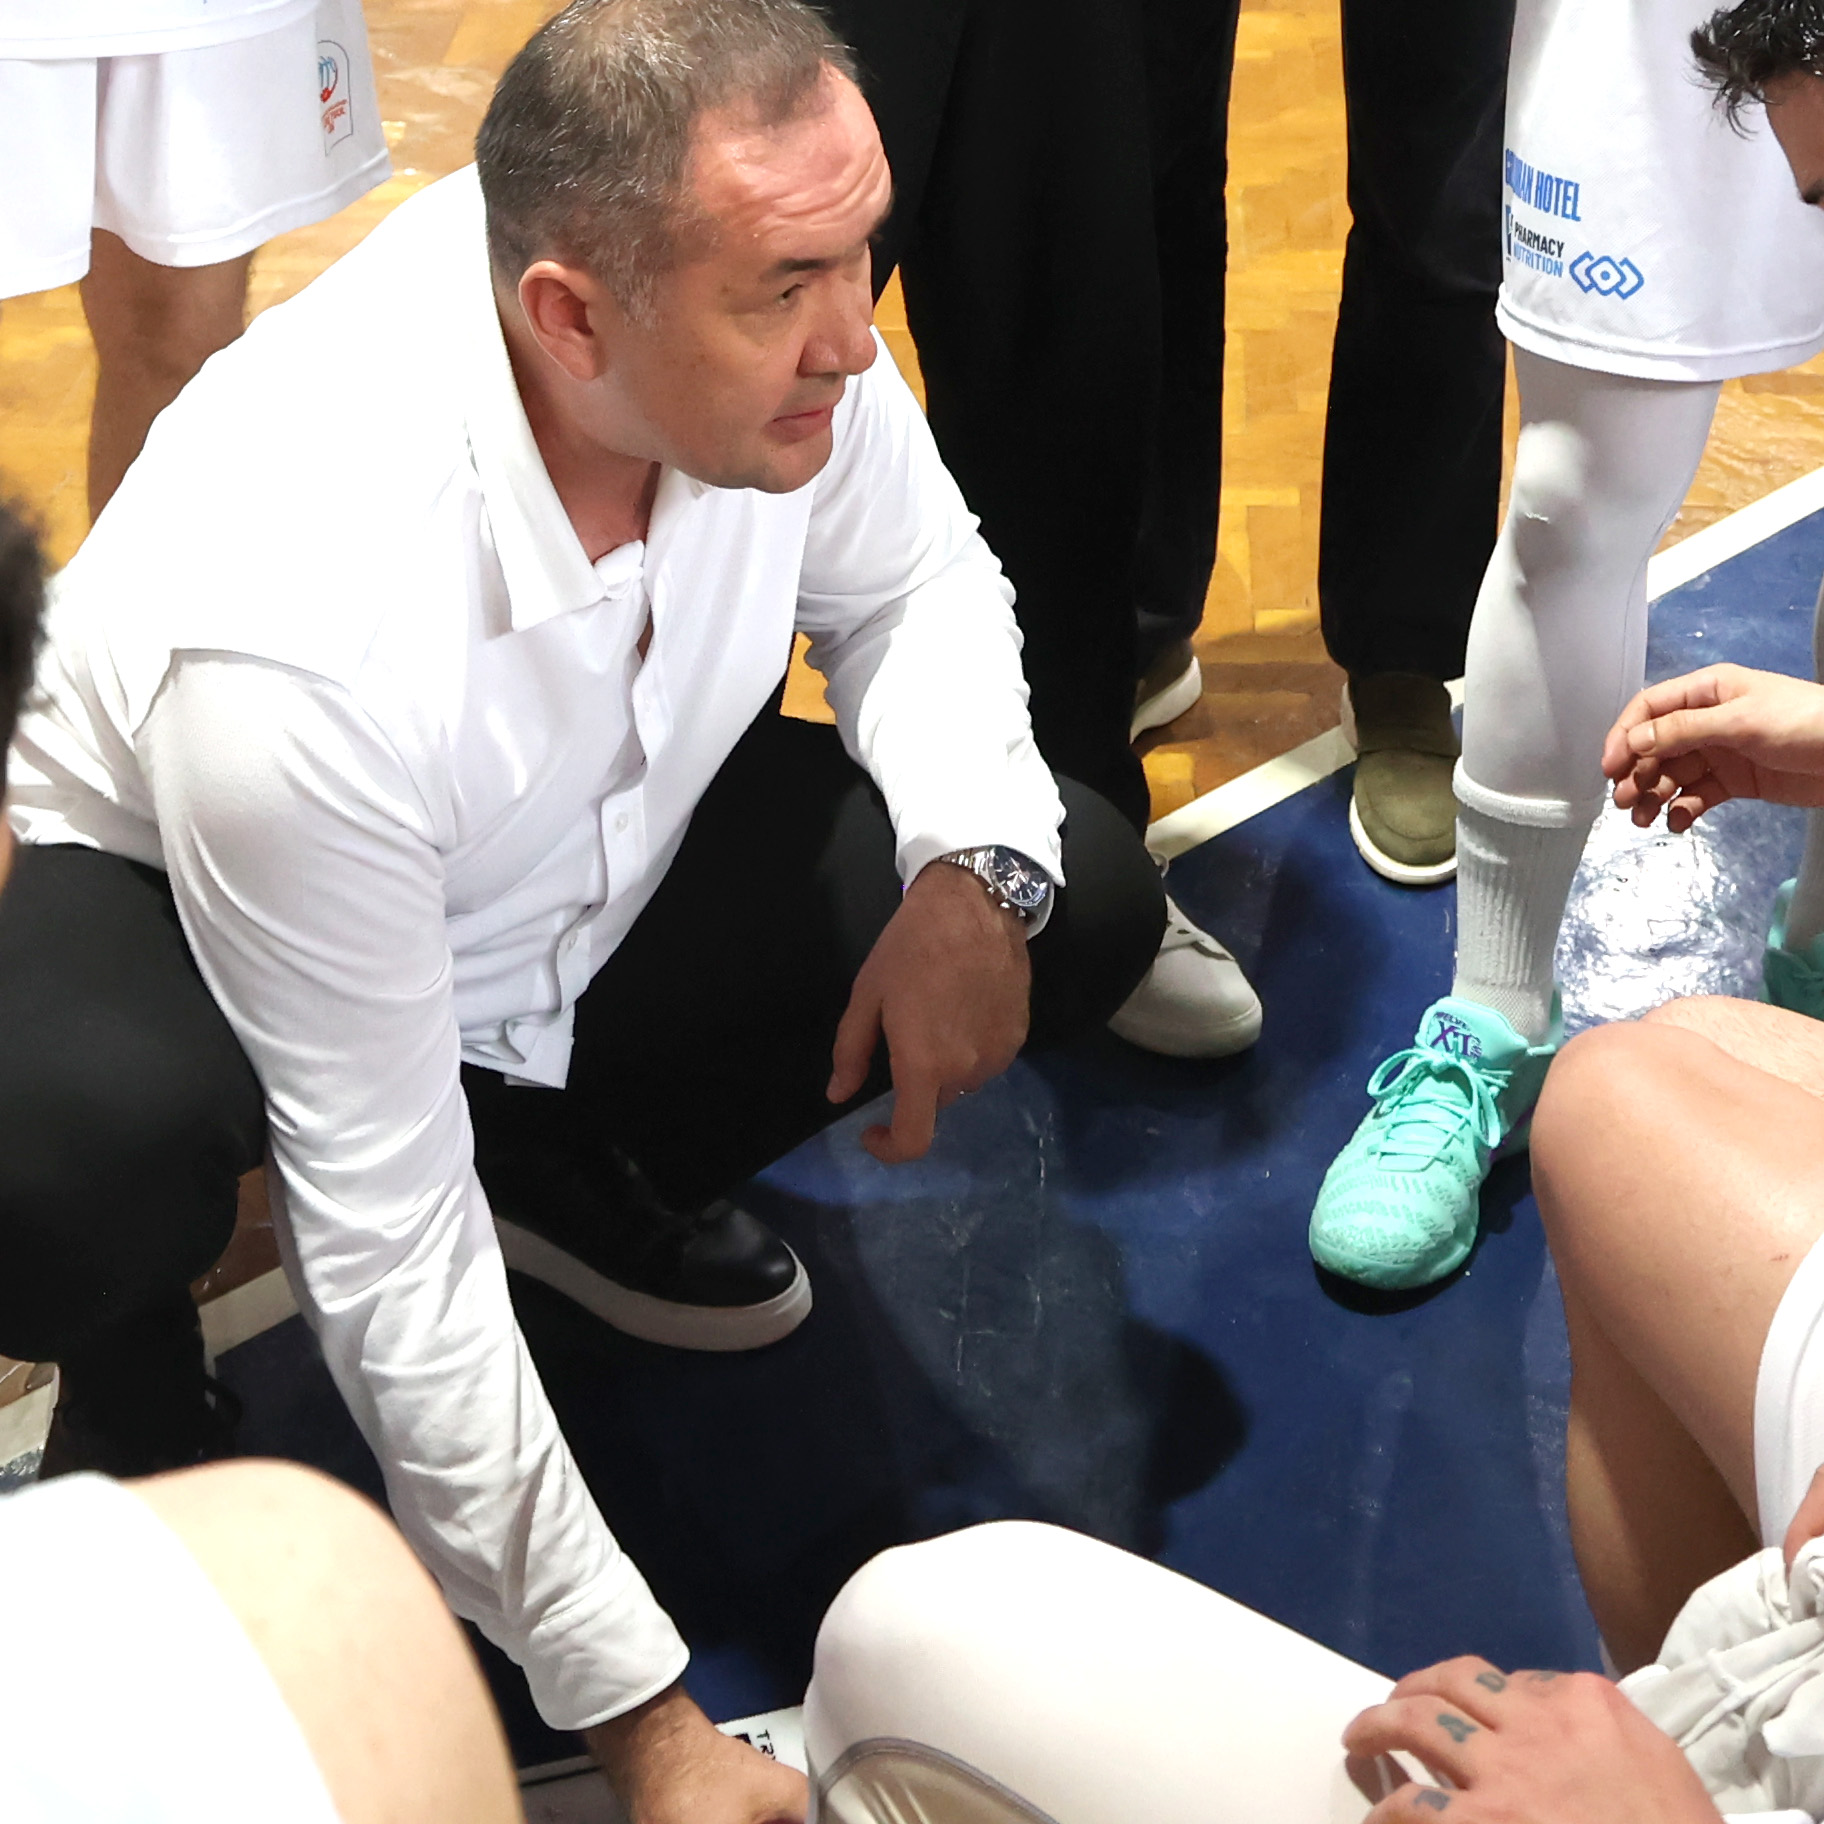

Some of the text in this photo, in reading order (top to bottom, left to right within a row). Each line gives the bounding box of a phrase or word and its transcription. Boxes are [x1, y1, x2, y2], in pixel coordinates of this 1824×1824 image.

[1533, 169, 1582, 223] HOTEL
[1514, 221, 1566, 258] PHARMACY
[1513, 244, 1564, 278] NUTRITION
